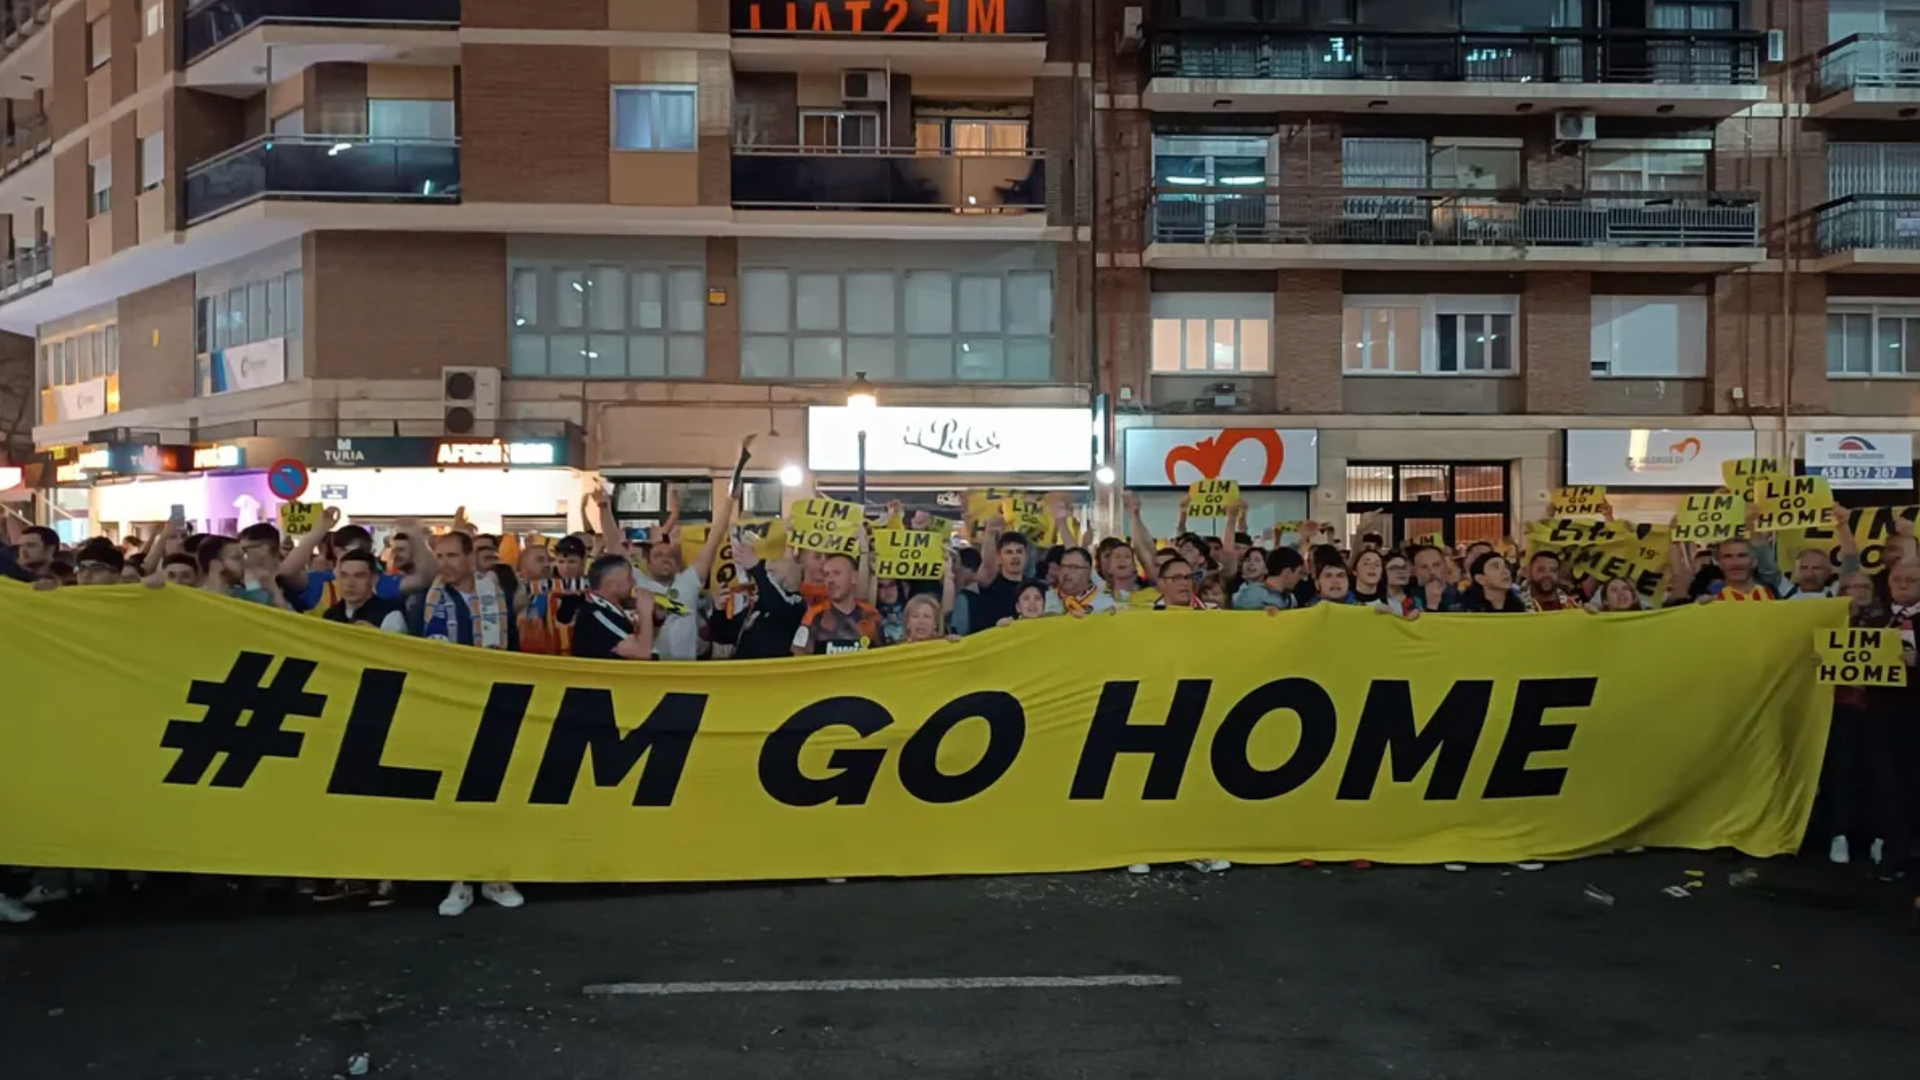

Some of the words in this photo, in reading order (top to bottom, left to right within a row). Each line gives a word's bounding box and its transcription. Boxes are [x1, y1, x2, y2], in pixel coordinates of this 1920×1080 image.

[325, 451, 365, 461] TURIA
[1736, 459, 1777, 475] LIM
[1847, 467, 1870, 478] 057
[1873, 467, 1897, 478] 207
[1199, 481, 1231, 493] LIM
[1560, 487, 1595, 497] LIM
[1767, 478, 1814, 499] LIM
[1205, 494, 1223, 503] GO
[1687, 496, 1733, 511] LIM
[1780, 497, 1805, 509] GO
[806, 499, 851, 520] LIM
[1188, 504, 1238, 517] HOM
[1554, 504, 1603, 514] HOME
[1698, 512, 1722, 522] GO
[1758, 508, 1832, 528] HOME
[814, 519, 835, 531] GO
[1675, 524, 1746, 539] HOME
[790, 530, 858, 552] HOME
[890, 530, 932, 548] LIM
[900, 549, 921, 559] GO
[878, 561, 942, 578] HOME
[1829, 630, 1880, 648] LIM
[1843, 651, 1871, 662] GO
[1821, 665, 1901, 682] HOME
[160, 651, 708, 806] #LIM
[759, 691, 1025, 806] GO
[1069, 677, 1598, 800] HOME
